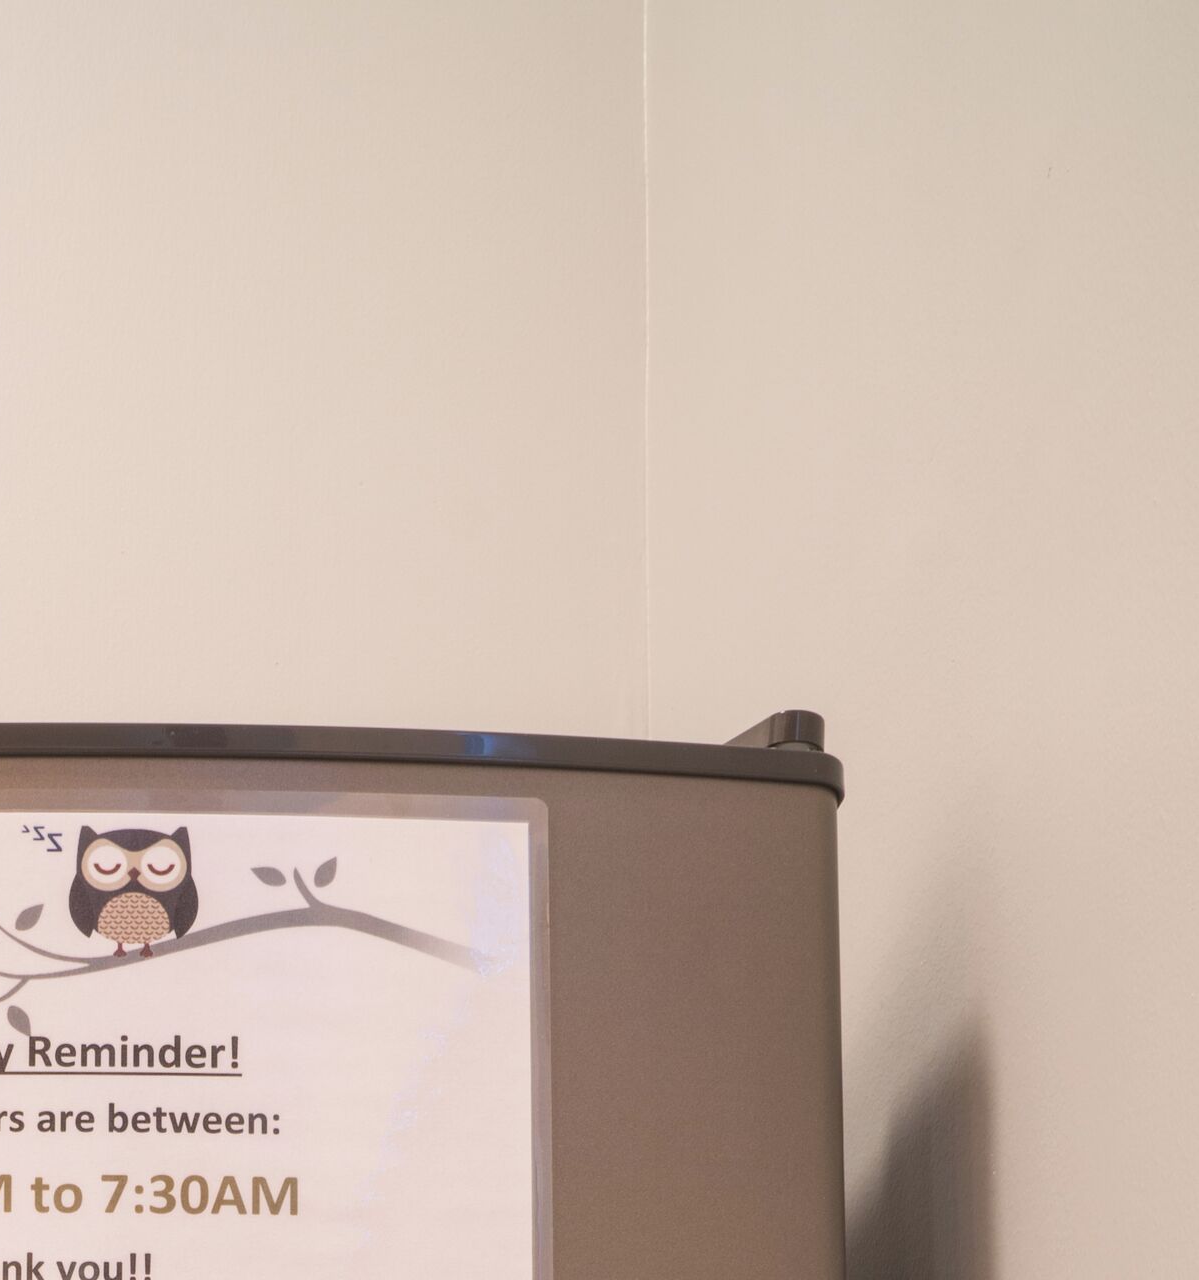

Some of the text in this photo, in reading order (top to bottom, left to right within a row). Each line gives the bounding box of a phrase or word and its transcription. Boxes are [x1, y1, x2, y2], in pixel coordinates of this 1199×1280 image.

[27, 1034, 240, 1070] Reminder!
[37, 1110, 96, 1134] are
[107, 1103, 281, 1136] between:
[29, 1176, 84, 1214] to
[100, 1174, 299, 1217] 7:30AM
